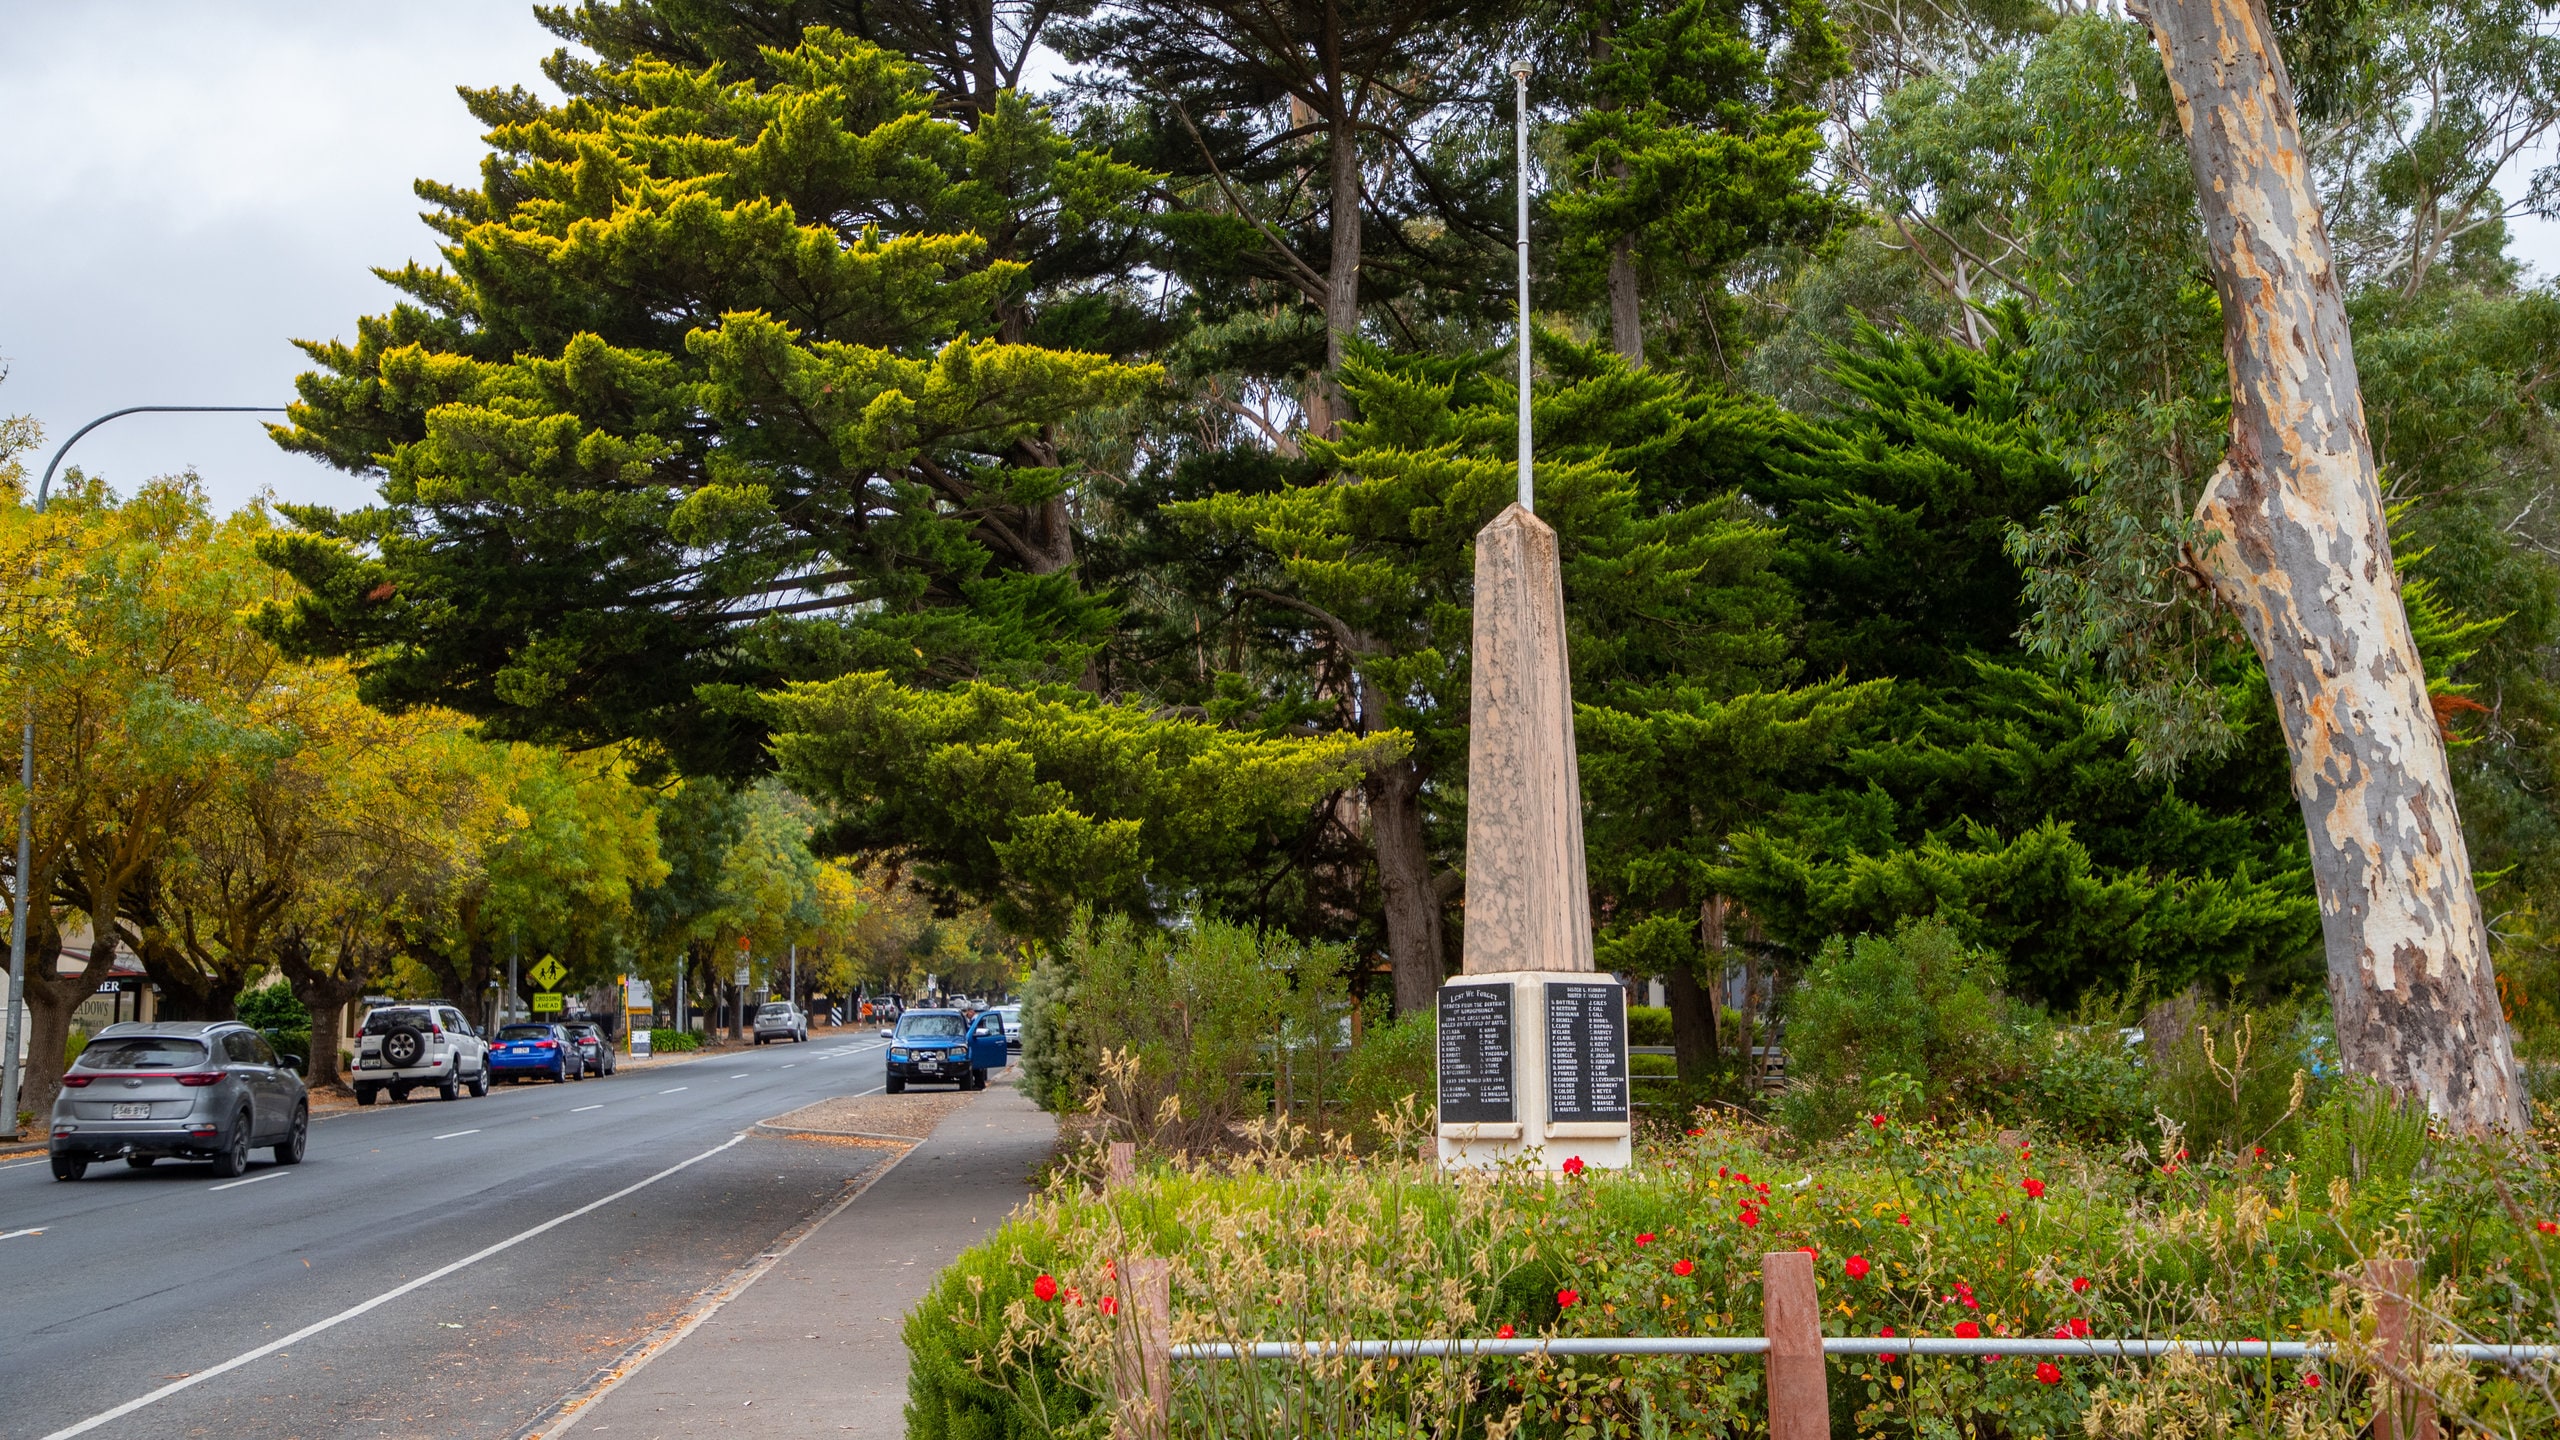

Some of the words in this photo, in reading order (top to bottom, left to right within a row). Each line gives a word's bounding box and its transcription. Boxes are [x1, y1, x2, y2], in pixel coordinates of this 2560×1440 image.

[1450, 992, 1464, 1003] LEST
[1466, 990, 1474, 998] WE
[1476, 989, 1498, 1000] FORGET
